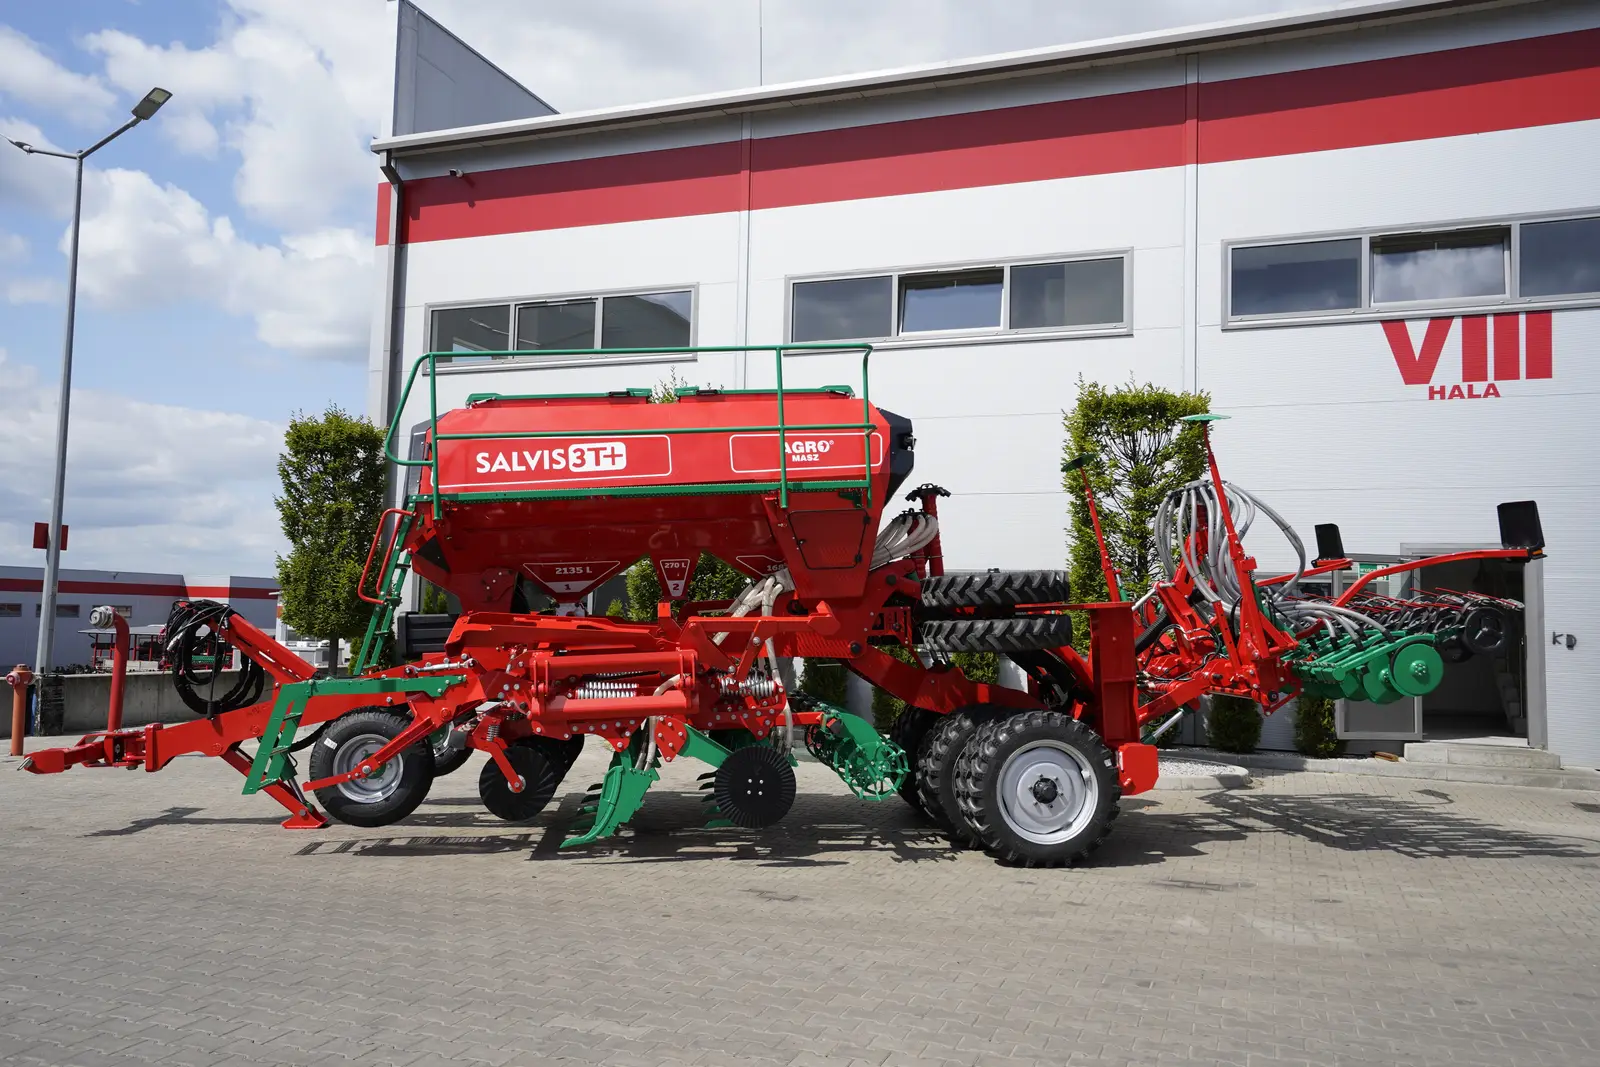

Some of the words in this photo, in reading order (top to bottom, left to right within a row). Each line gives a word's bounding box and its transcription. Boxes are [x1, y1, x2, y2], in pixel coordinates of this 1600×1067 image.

[1380, 310, 1552, 385] VIII
[1428, 383, 1501, 400] HALA
[791, 454, 820, 462] MASZ
[555, 566, 584, 575] 2135
[586, 566, 593, 574] L
[564, 583, 571, 591] 1
[672, 583, 680, 591] 2
